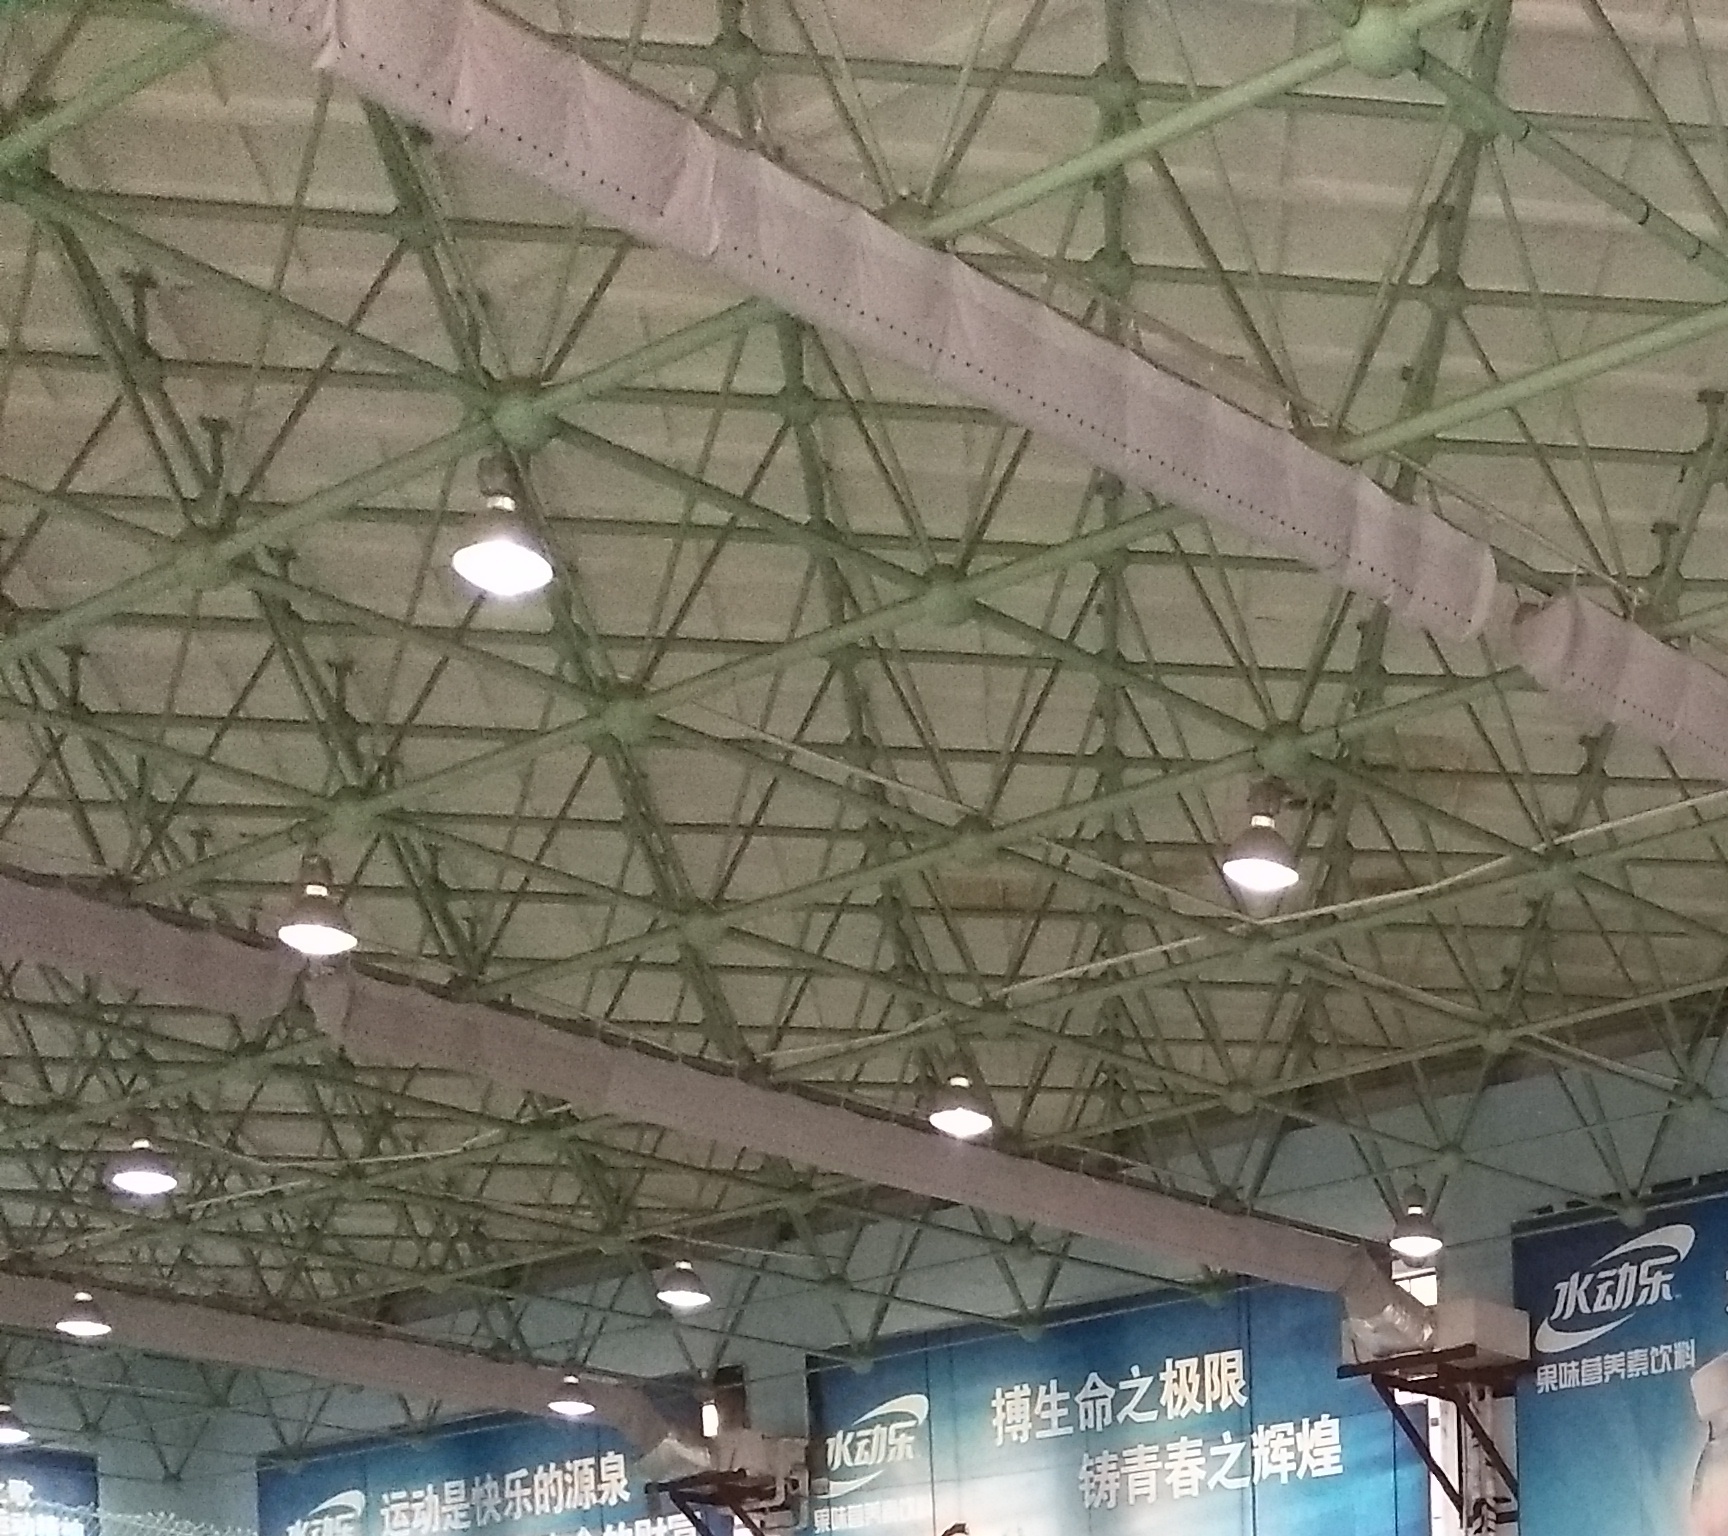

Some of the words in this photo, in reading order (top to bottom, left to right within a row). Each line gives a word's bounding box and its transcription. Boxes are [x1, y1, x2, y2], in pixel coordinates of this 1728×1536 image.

[990, 1348, 1248, 1448] 搏生命之极限
[1535, 1338, 1697, 1396] 果味营养素饮料
[1078, 1413, 1343, 1511] 铸青春之辉煌
